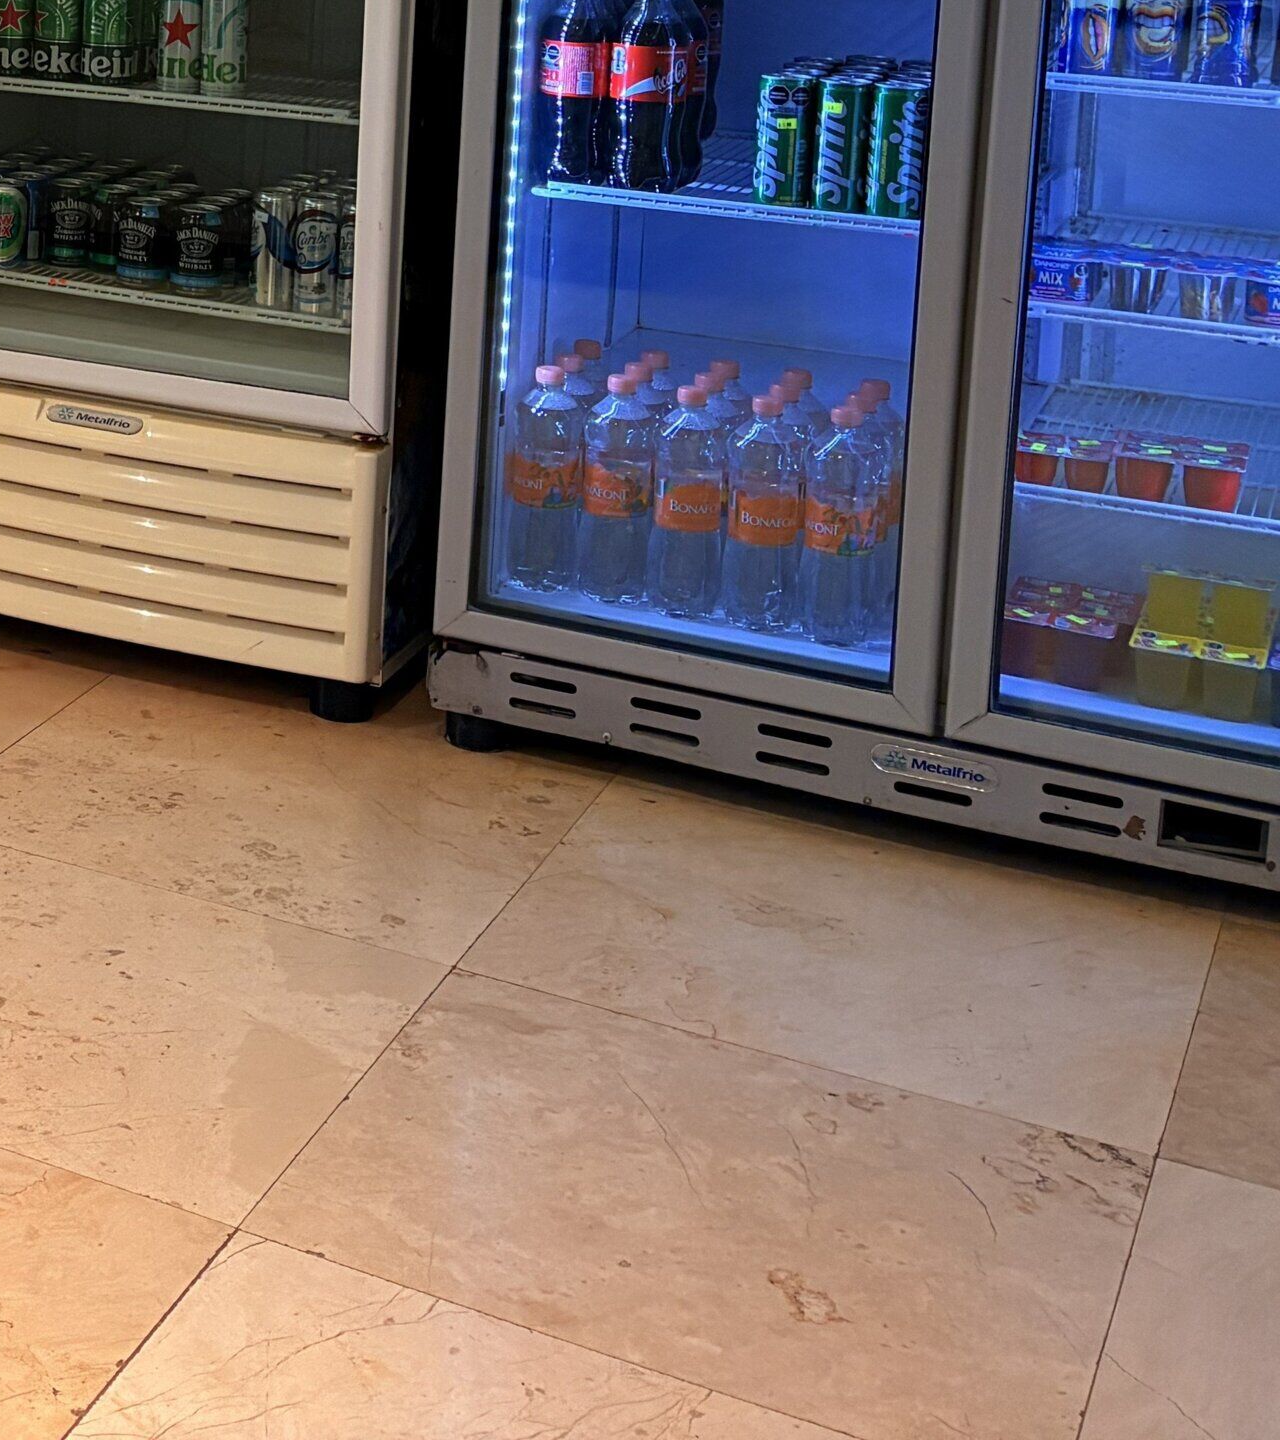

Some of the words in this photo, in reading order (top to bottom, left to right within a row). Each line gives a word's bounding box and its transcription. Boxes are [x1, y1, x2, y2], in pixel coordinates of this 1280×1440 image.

[1038, 270, 1064, 286] MIX
[75, 411, 131, 429] Metalfrio
[910, 758, 987, 783] Metalfrio
